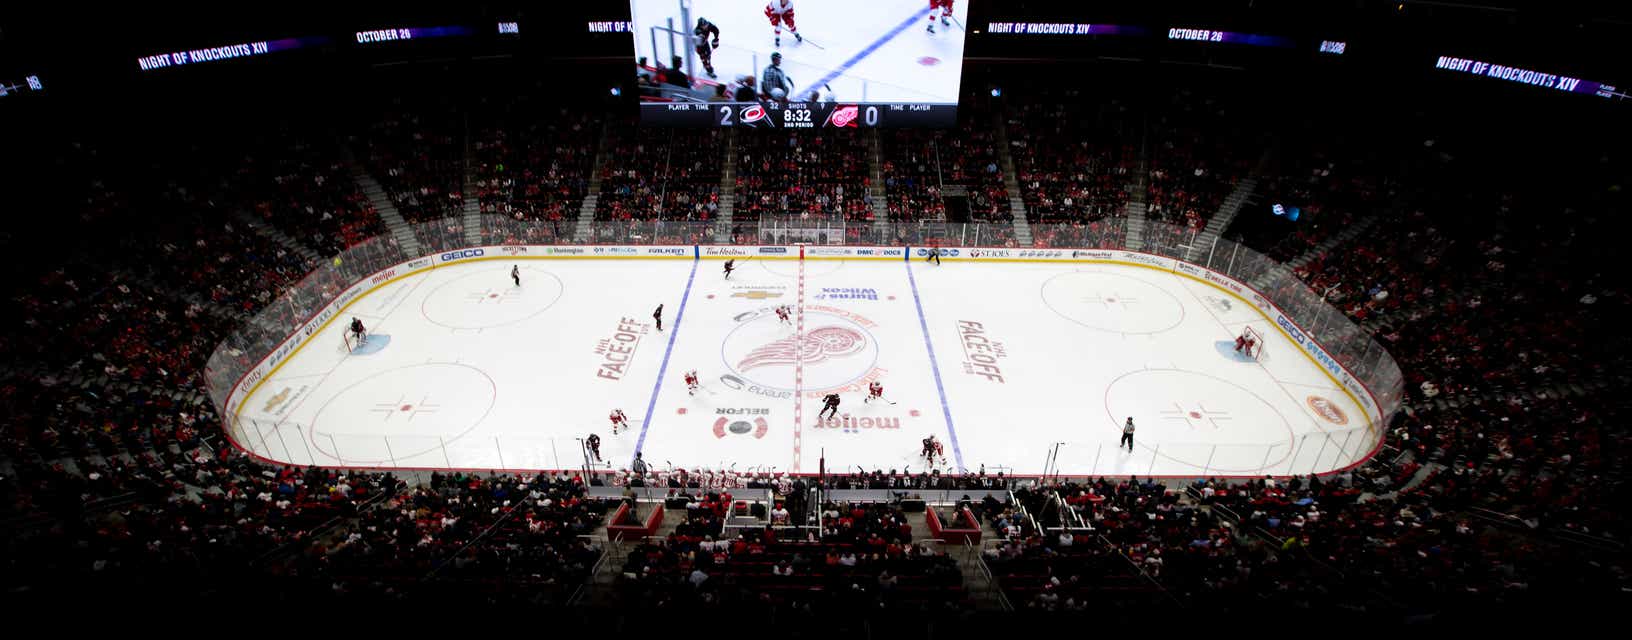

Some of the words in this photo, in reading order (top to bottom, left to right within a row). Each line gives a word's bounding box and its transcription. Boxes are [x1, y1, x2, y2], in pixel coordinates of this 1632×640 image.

[588, 21, 612, 33] NIGHT
[614, 21, 625, 33] OF
[988, 22, 1014, 33] NIGHT
[1014, 22, 1026, 33] OF
[1026, 22, 1075, 34] KNOCKOUTS
[1075, 23, 1090, 34] XIV
[356, 28, 399, 43] OCTOBER
[399, 28, 411, 40] 26
[1168, 28, 1210, 41] OCTOBER
[1210, 31, 1223, 42] 26
[138, 53, 171, 71] NIGHT
[172, 51, 188, 66] OF
[189, 44, 252, 64] KNOCKOUTS
[251, 41, 268, 55] XIV
[1436, 55, 1473, 72] NIGHT
[1472, 61, 1489, 75] OF
[1487, 63, 1556, 87] KNOCKOUTS
[1555, 76, 1580, 92] XIV
[720, 105, 733, 126] 2
[783, 109, 811, 122] 8:32
[865, 105, 878, 126] 0
[441, 248, 484, 261] GEICO
[719, 247, 746, 255] Hortons
[371, 270, 396, 284] meijer
[1277, 315, 1305, 345] GEICO
[594, 338, 611, 355] NHL
[991, 341, 1008, 357] NHL
[747, 385, 792, 399] arena
[715, 407, 770, 415] BELFOR
[813, 413, 901, 434] meijer
